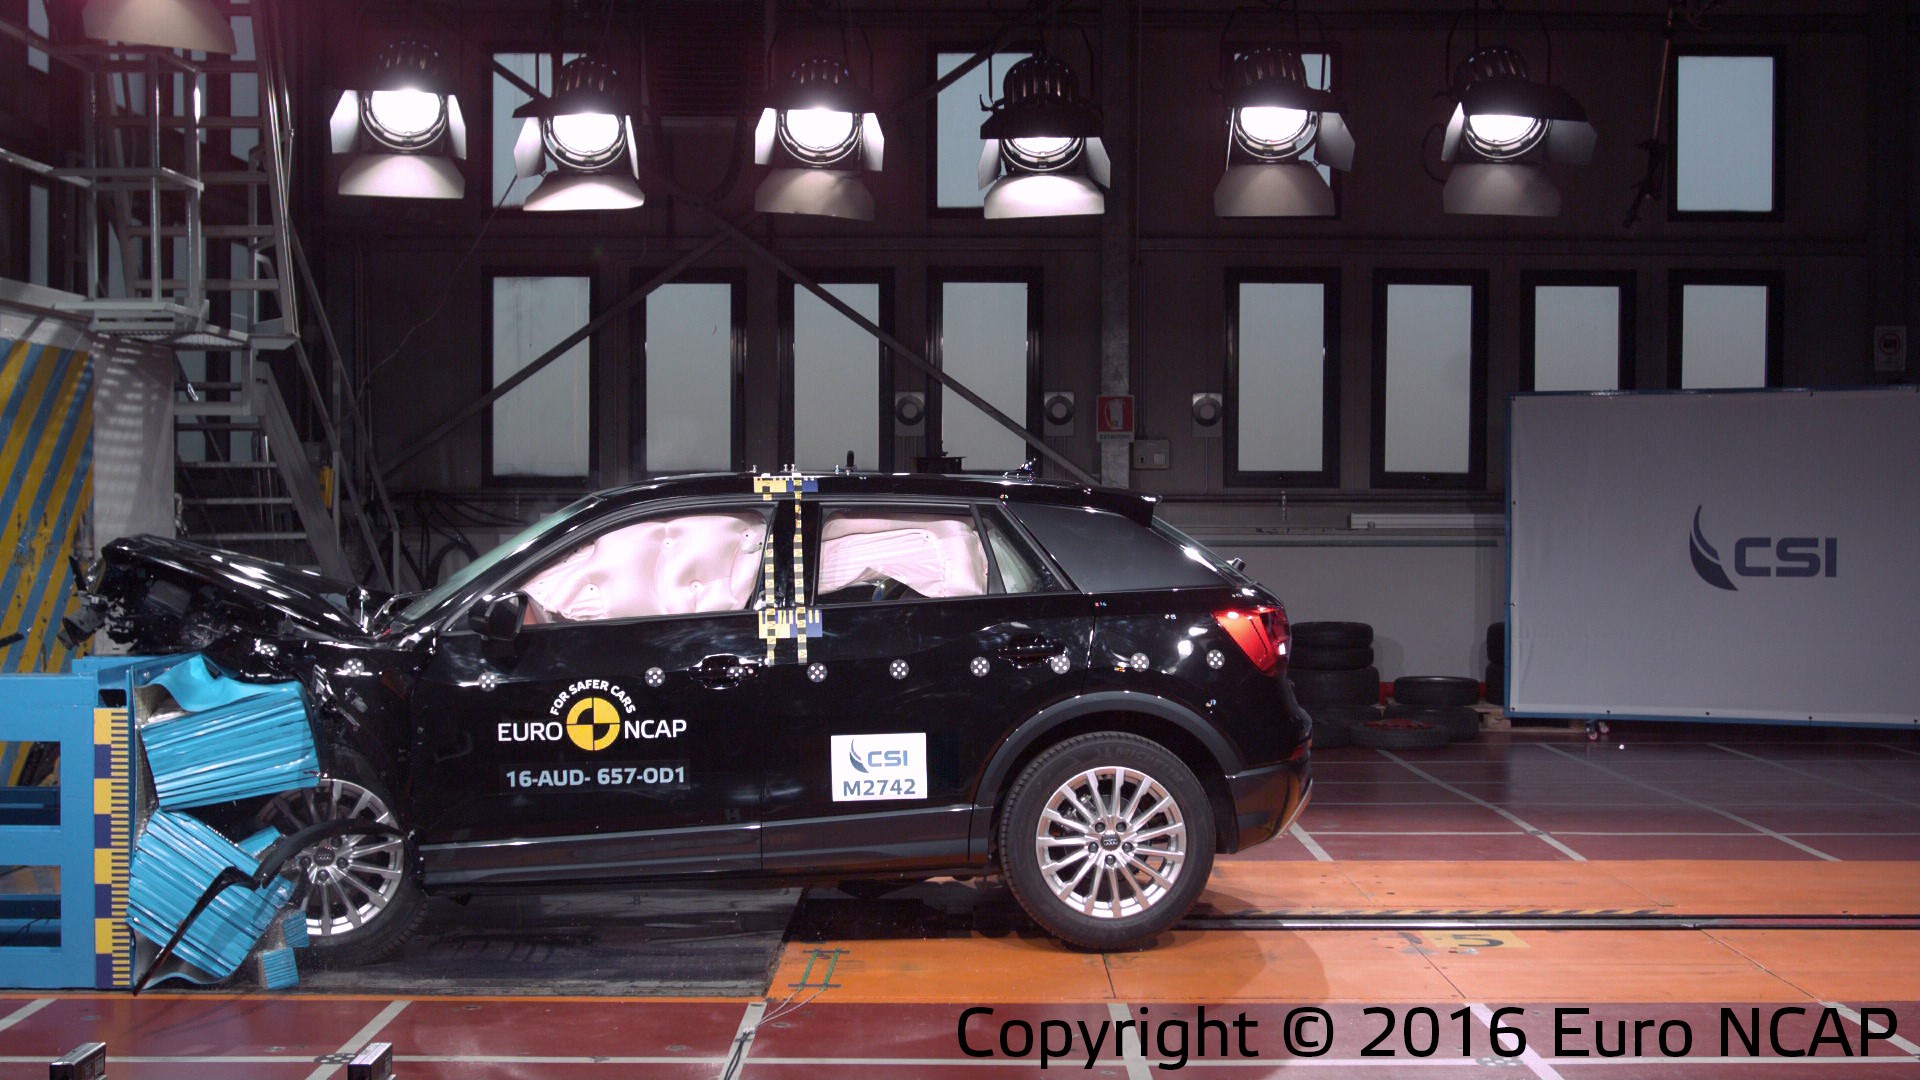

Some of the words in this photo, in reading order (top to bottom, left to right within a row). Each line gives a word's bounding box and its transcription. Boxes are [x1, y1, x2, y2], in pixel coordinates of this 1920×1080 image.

[1734, 537, 1837, 577] CSI
[550, 691, 571, 716] FOR
[568, 679, 610, 695] SAFER
[610, 685, 637, 714] CARS
[498, 722, 563, 741] EURO
[624, 719, 687, 739] NCAP
[867, 750, 908, 767] CSI
[843, 778, 916, 796] M2742
